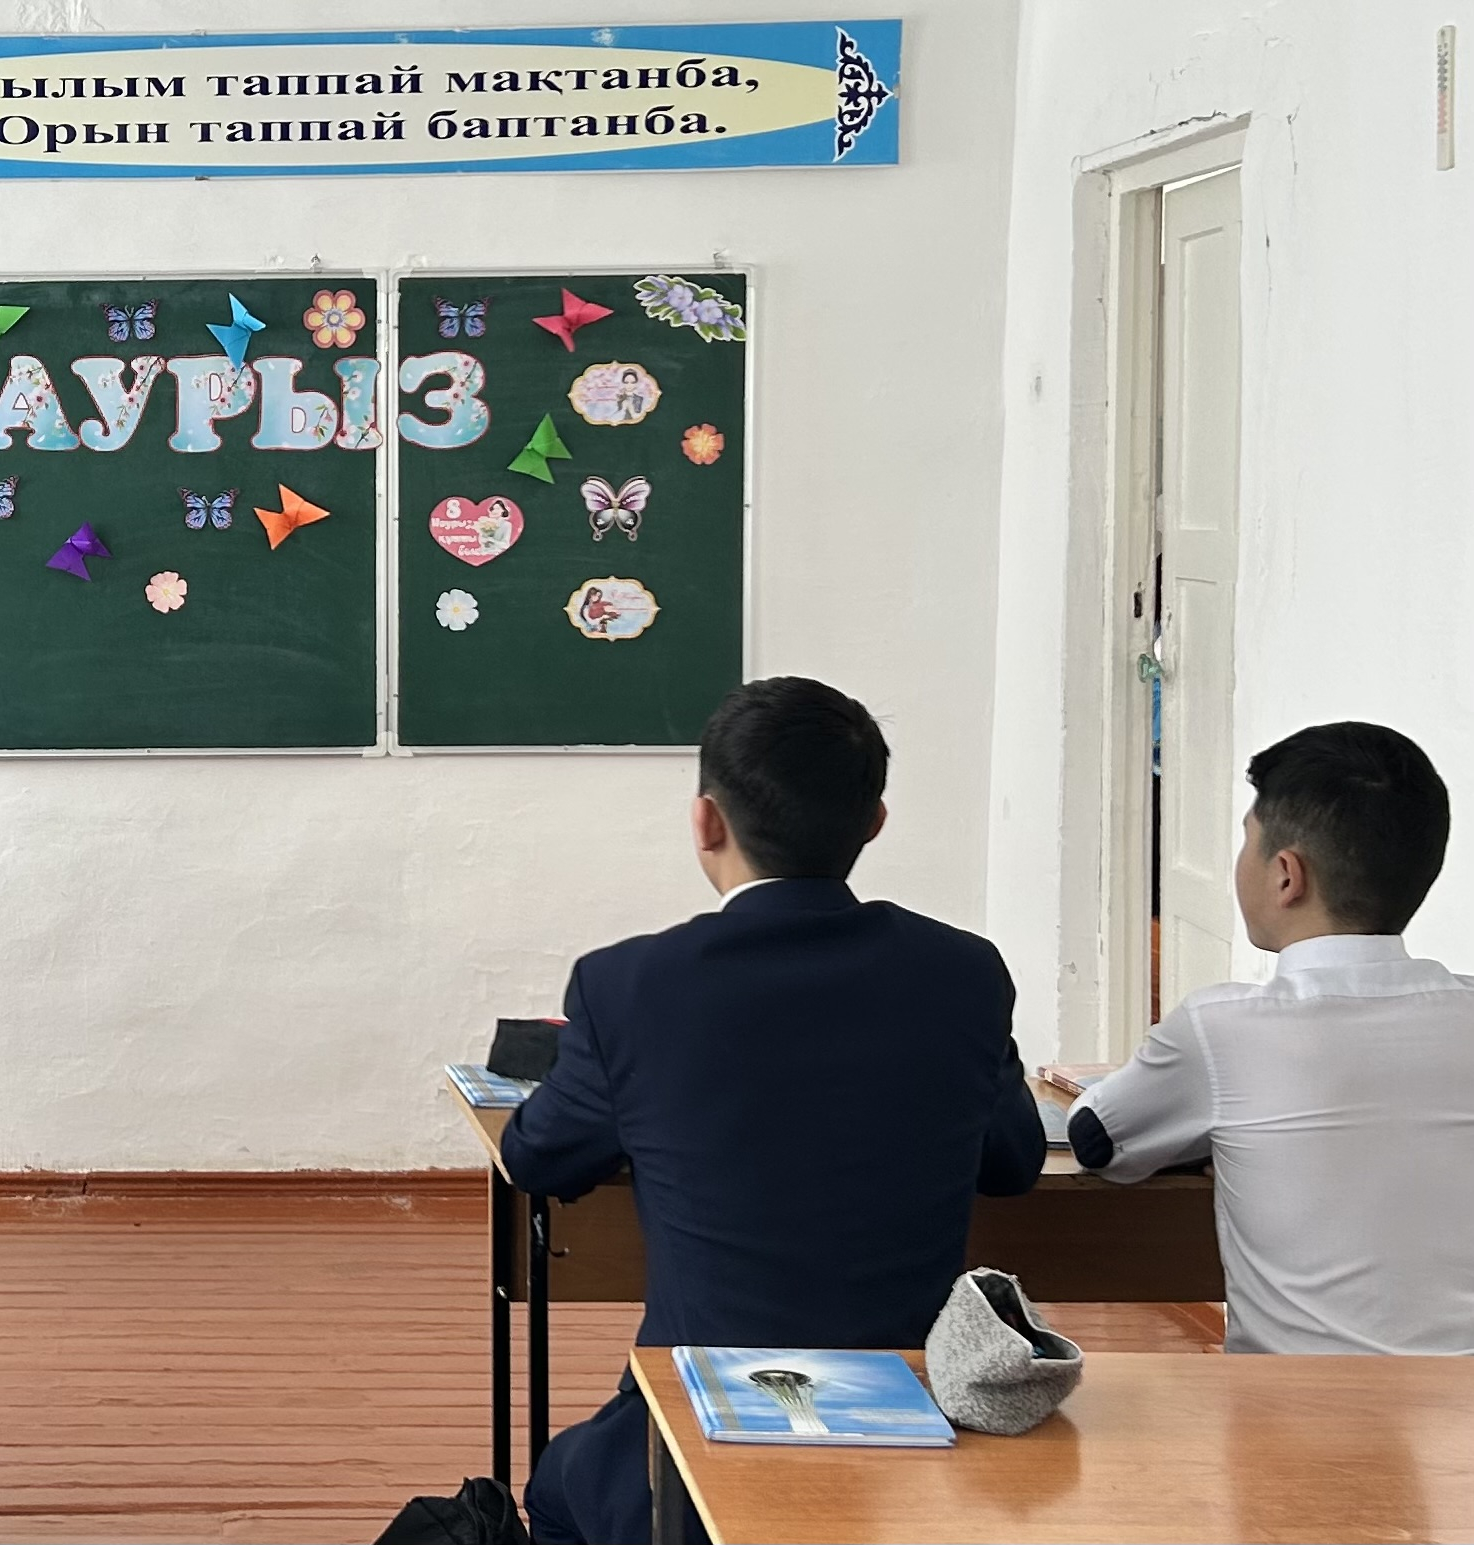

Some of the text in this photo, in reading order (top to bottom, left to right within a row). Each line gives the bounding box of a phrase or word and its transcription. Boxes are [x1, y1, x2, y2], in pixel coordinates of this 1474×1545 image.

[207, 64, 424, 98] таппай
[445, 56, 760, 96] мақтанба,
[189, 111, 406, 143] таппай
[427, 105, 728, 140] баптанба.
[446, 500, 461, 519] 8
